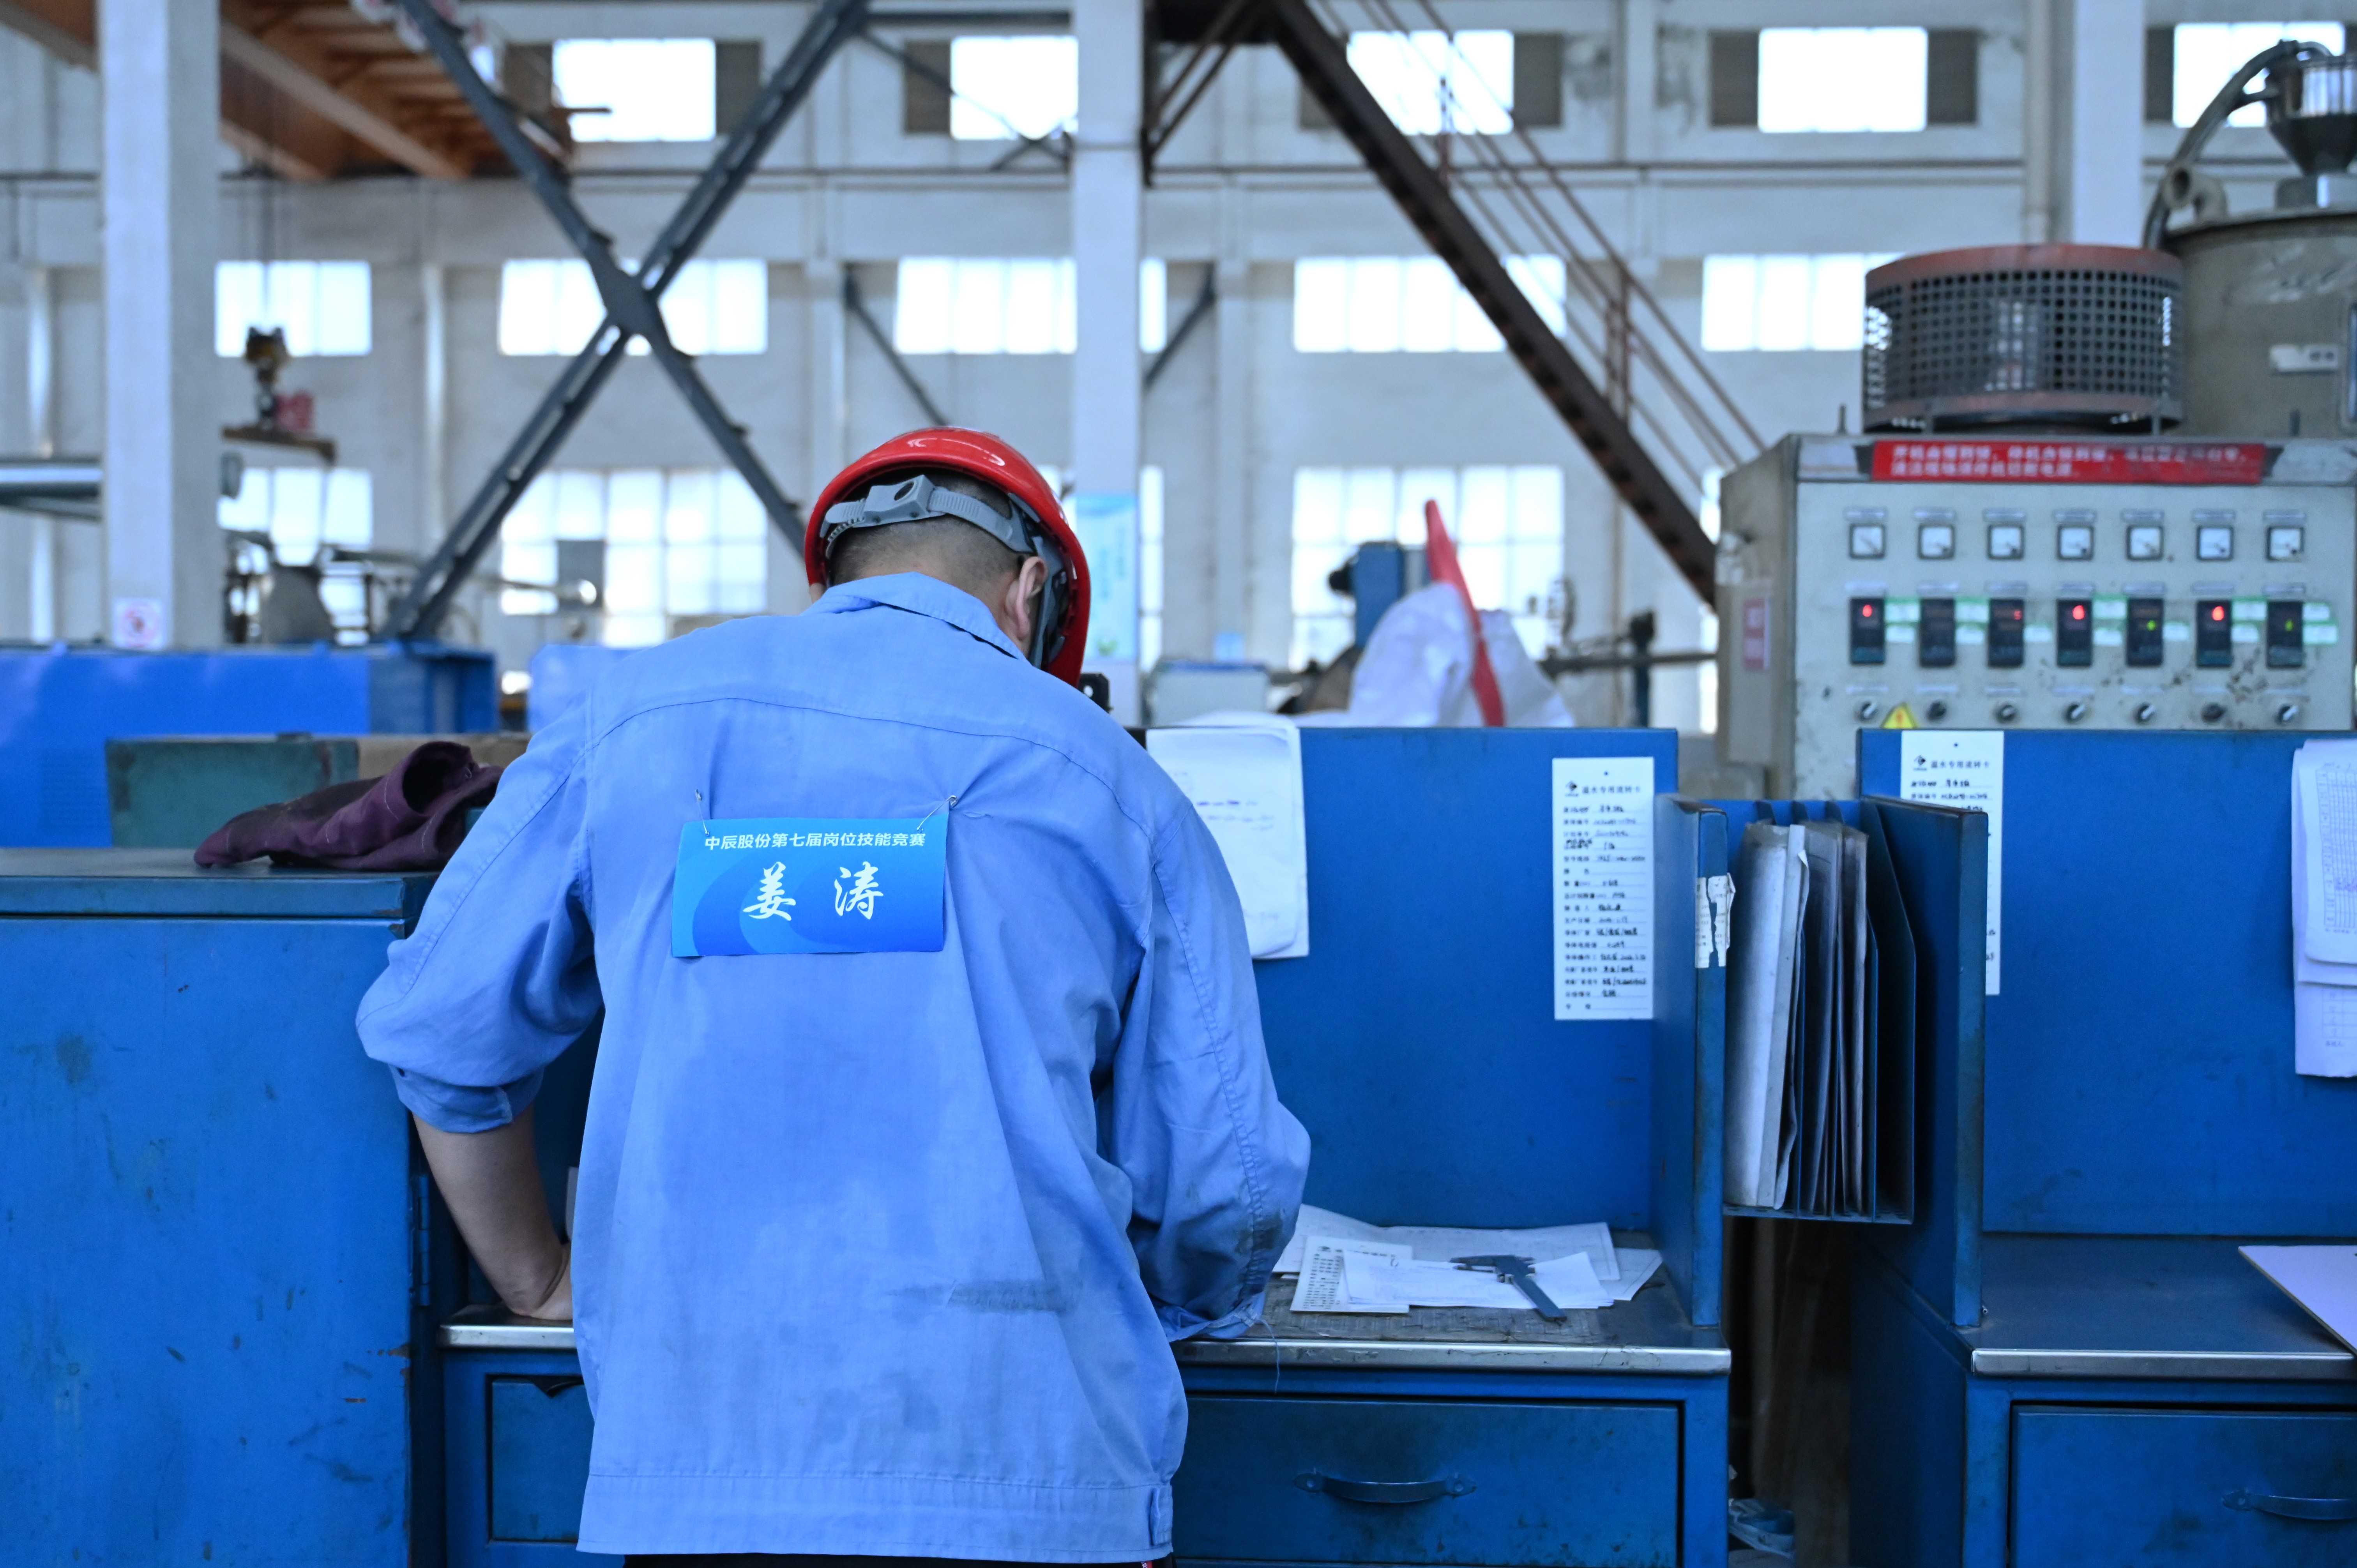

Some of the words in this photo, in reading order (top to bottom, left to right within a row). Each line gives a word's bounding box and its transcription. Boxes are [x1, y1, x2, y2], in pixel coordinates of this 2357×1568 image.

[705, 832, 926, 851] 中辰股份第七届岗位技能竞赛
